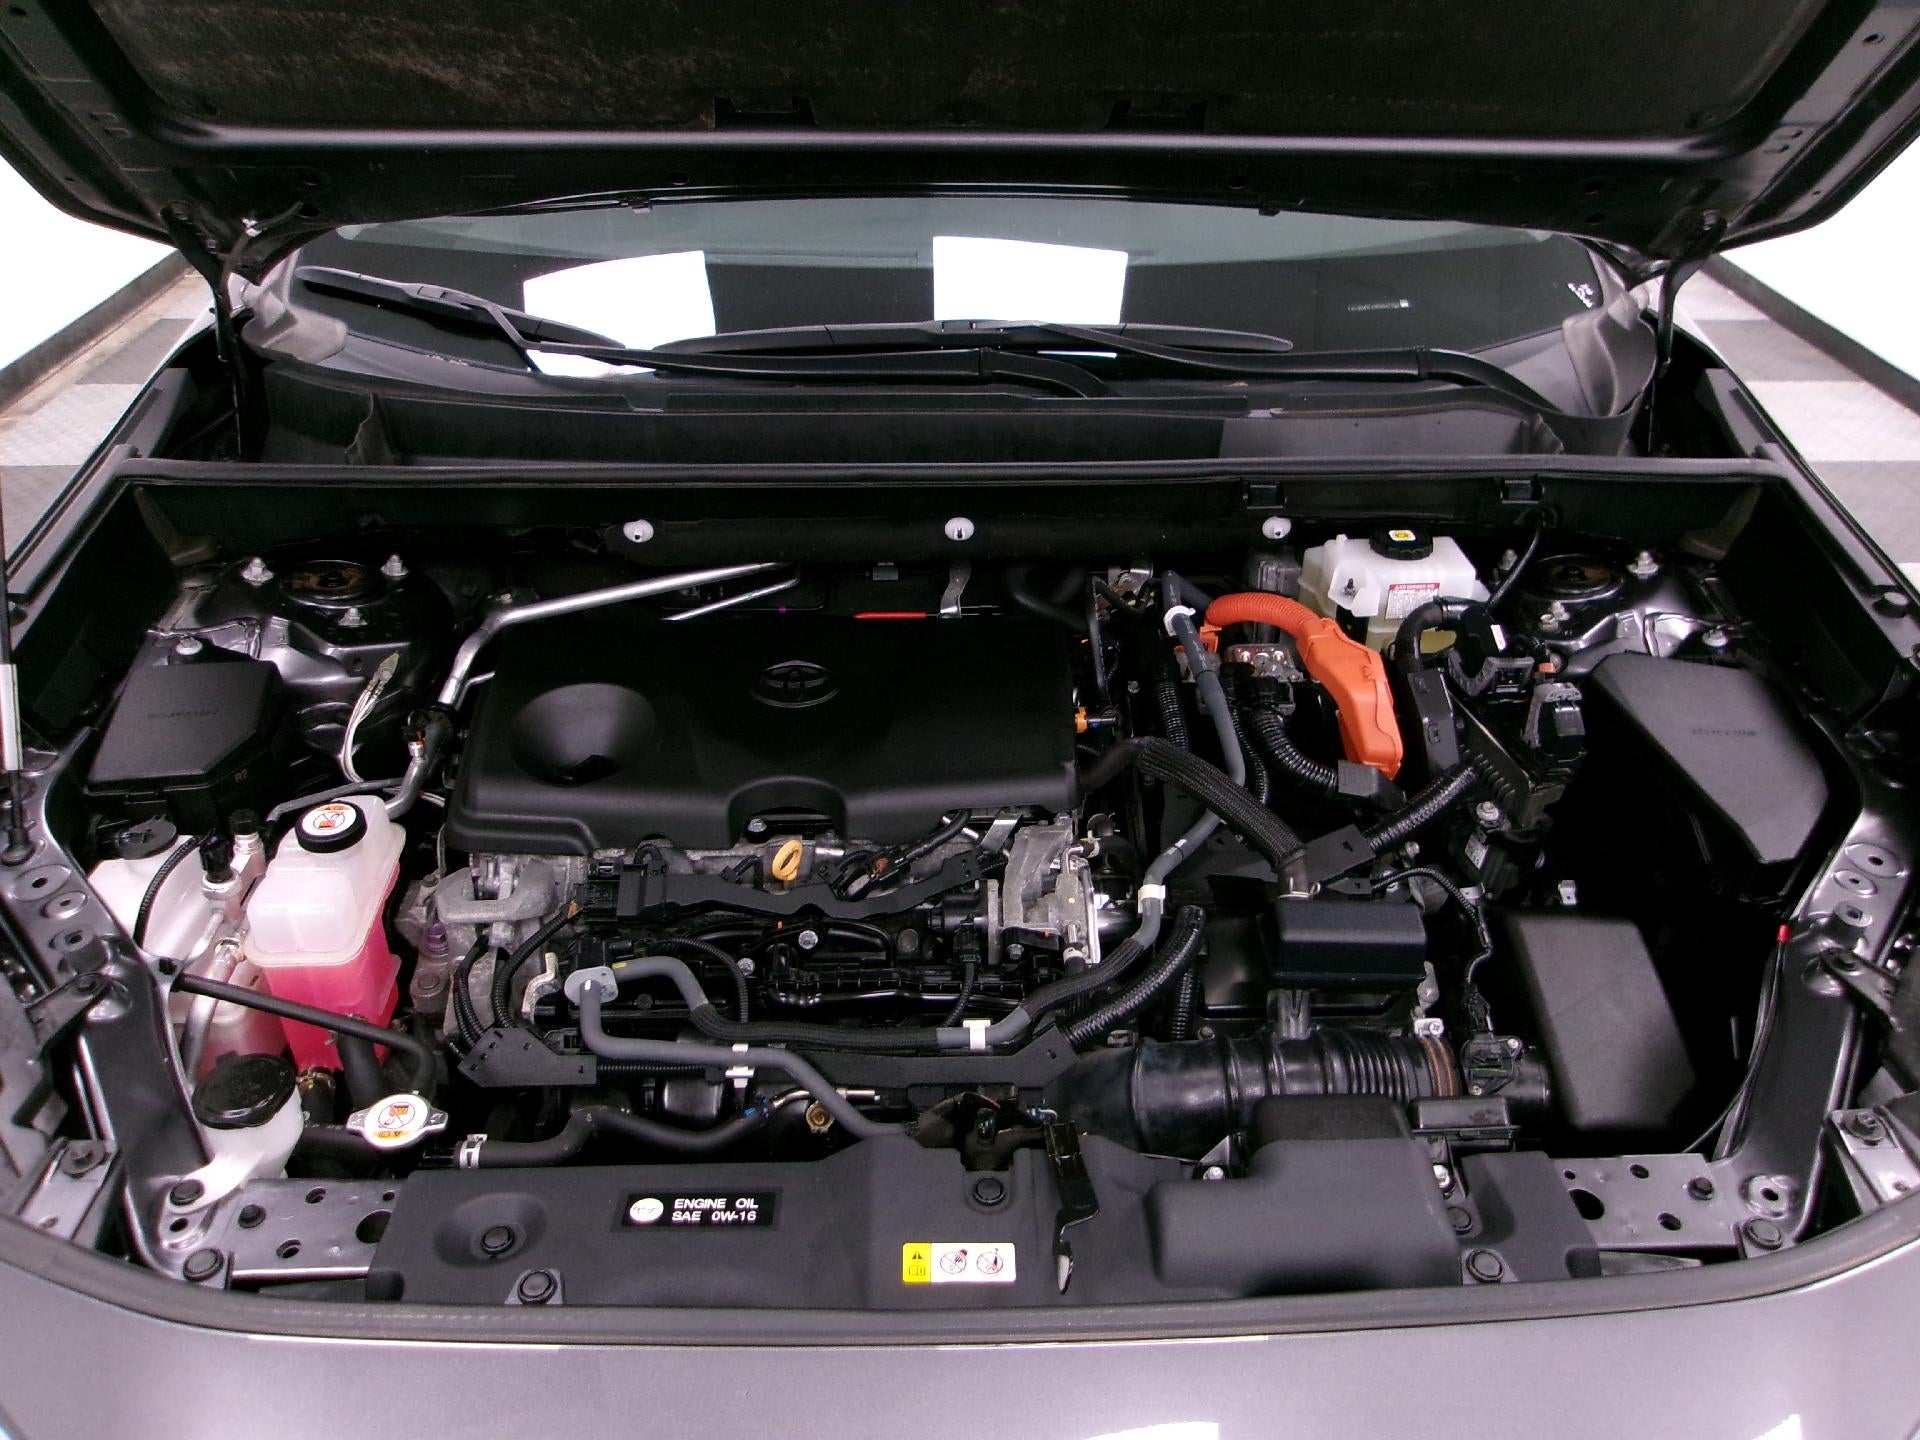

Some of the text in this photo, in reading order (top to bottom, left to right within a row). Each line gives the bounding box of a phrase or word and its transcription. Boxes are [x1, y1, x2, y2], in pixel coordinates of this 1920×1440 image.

[673, 1198, 759, 1209] ENGINE OIL
[671, 1210, 757, 1221] SAE 0W-16
